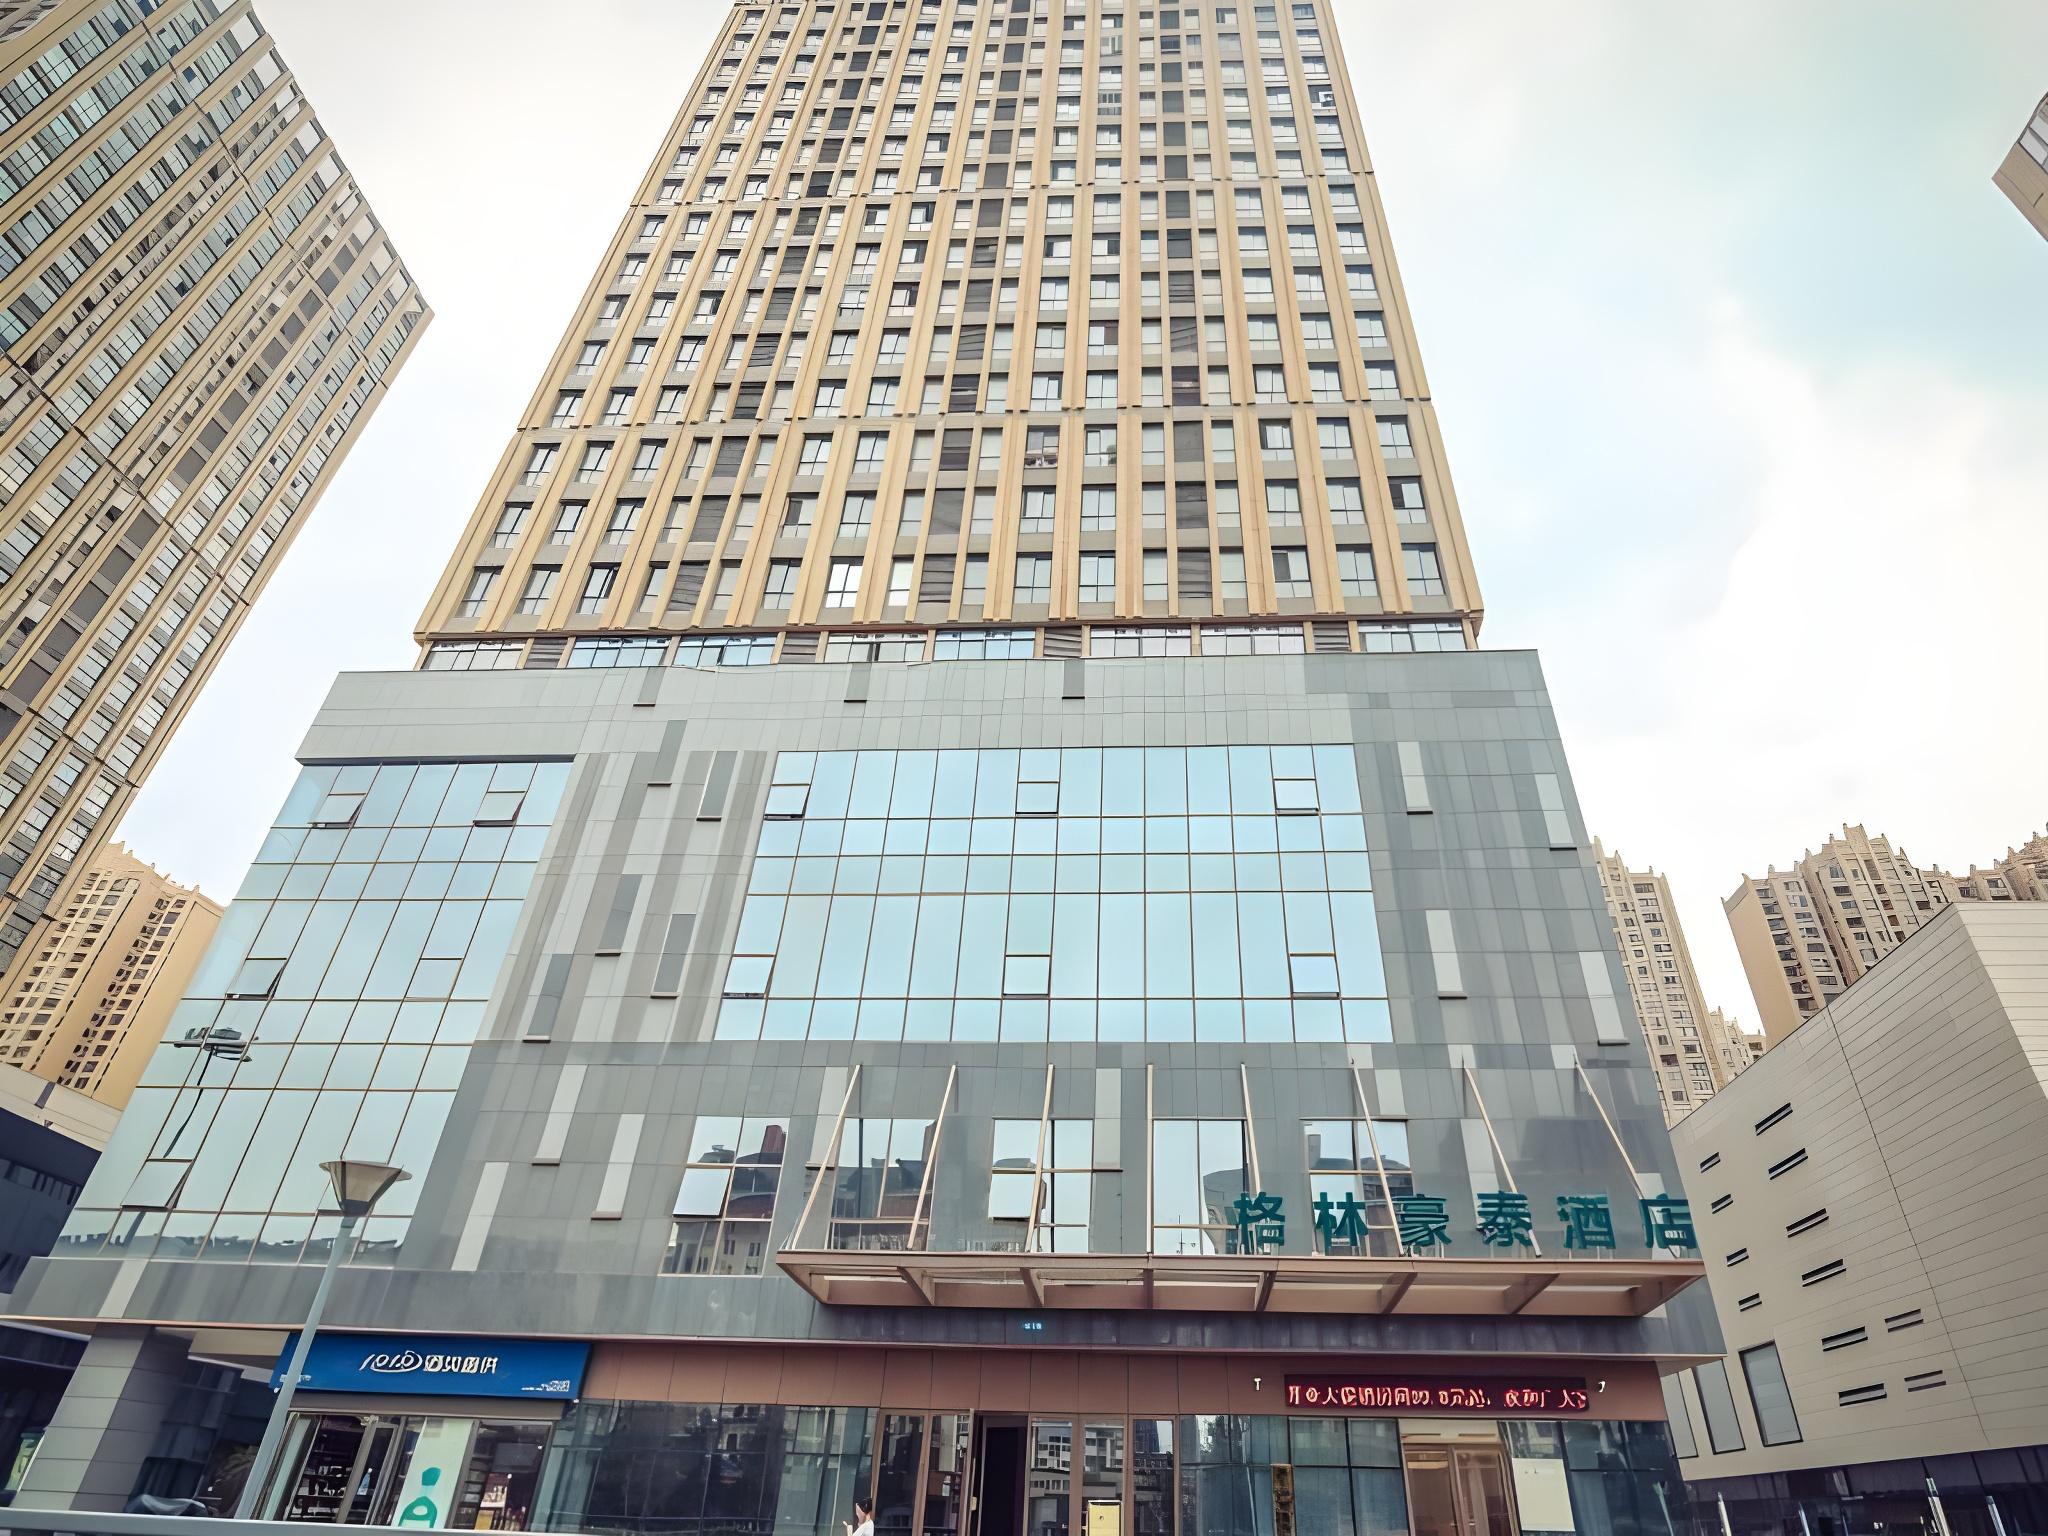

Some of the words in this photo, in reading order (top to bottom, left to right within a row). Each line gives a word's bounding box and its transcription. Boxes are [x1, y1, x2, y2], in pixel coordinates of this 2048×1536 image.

[1234, 1190, 1697, 1252] 格林豪泰酒店
